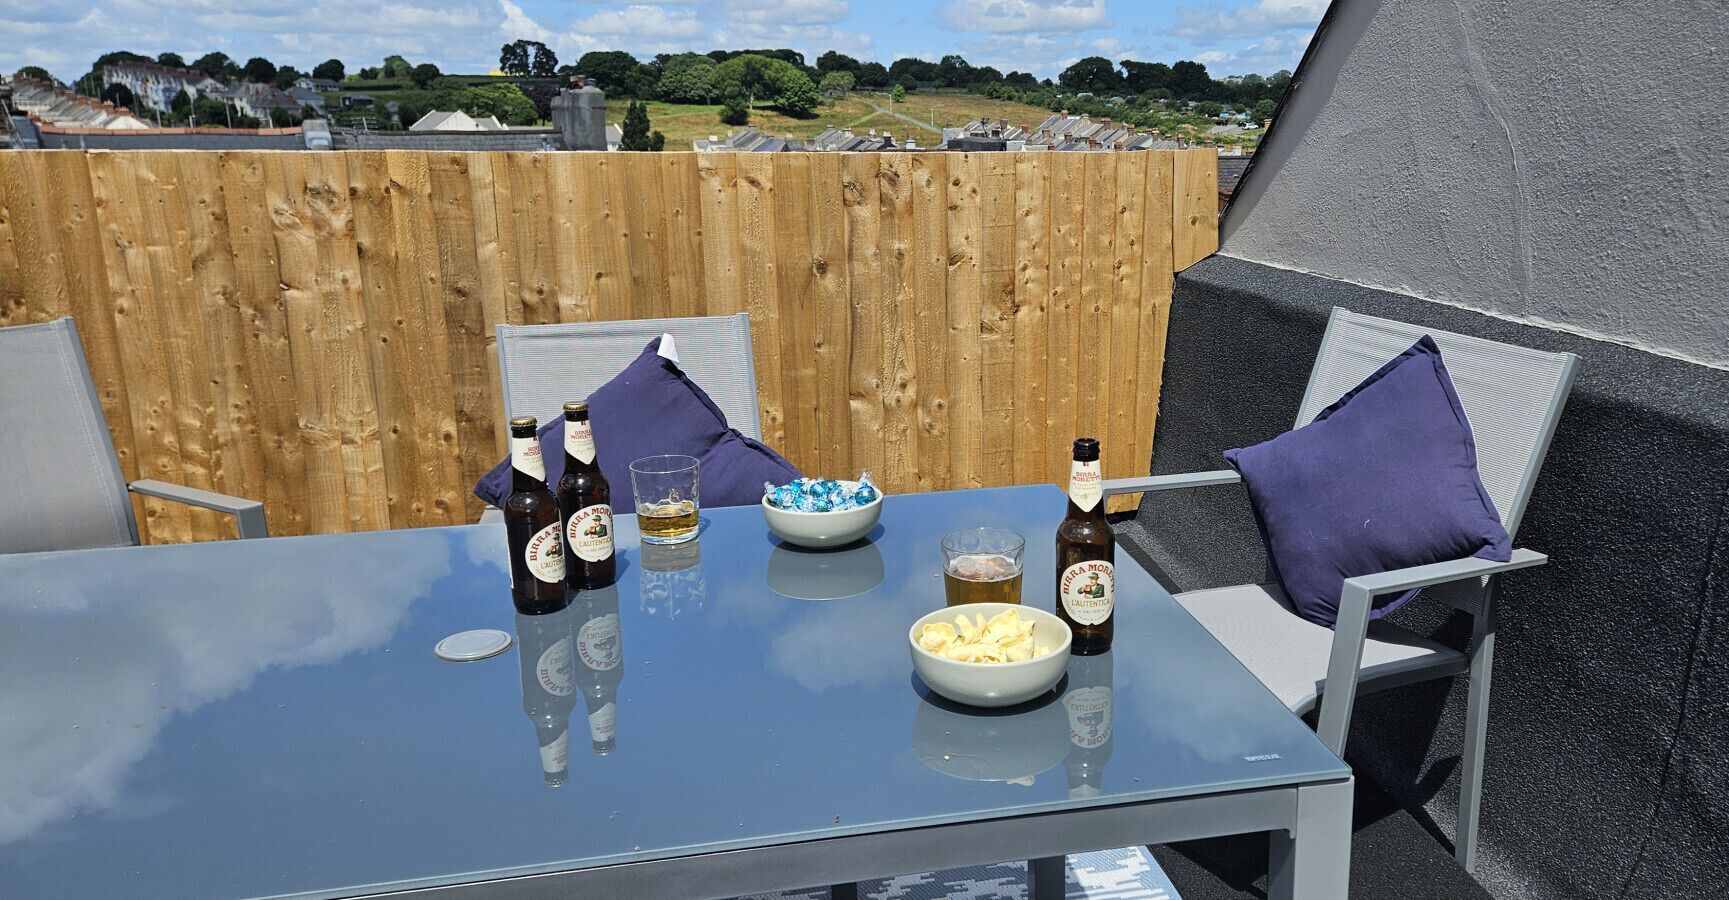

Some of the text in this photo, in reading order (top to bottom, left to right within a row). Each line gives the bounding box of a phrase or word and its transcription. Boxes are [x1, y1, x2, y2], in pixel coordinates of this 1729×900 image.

[569, 510, 591, 539] BIRRA
[529, 531, 553, 562] BIRRA
[1063, 565, 1087, 595] BIRRA
[1071, 597, 1110, 608] L'AUTENTICA
